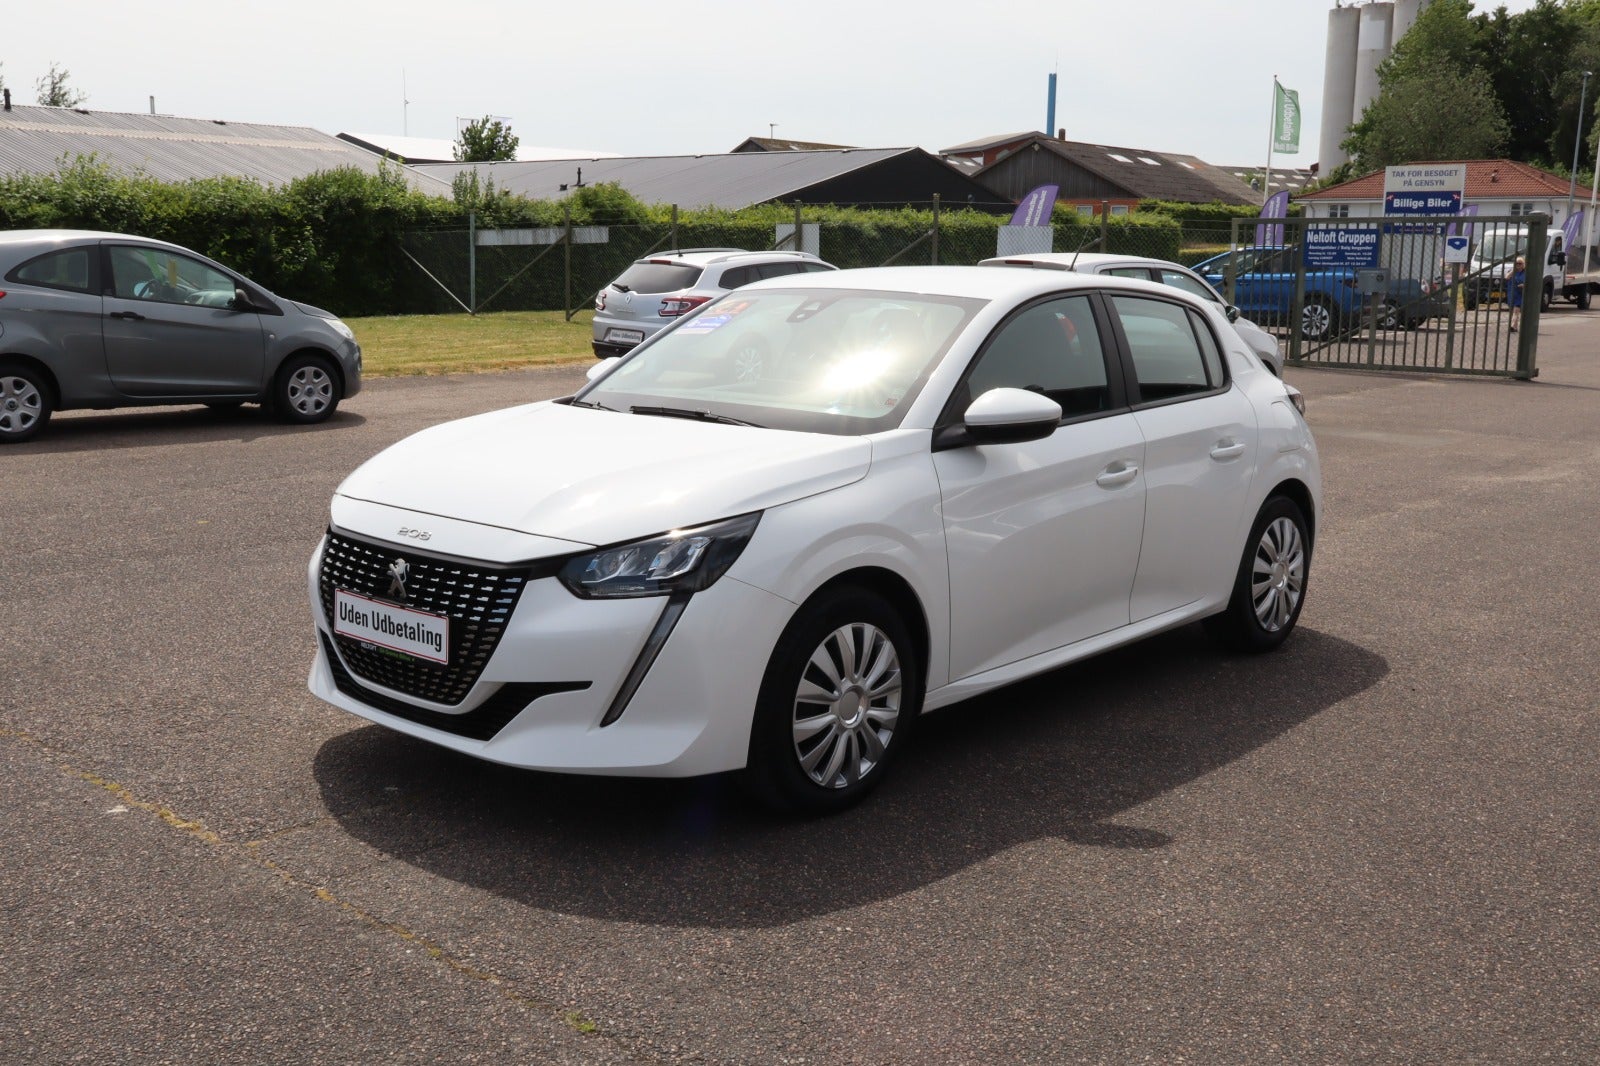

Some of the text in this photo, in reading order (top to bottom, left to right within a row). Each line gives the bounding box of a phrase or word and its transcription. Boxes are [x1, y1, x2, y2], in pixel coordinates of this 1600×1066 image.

[1392, 170, 1405, 178] TAK
[1424, 169, 1458, 177] BESØGET
[1403, 179, 1445, 187] PÅ GENSYN
[1393, 197, 1452, 209] Billige Biler
[1306, 230, 1376, 245] Neltoft Gruppen
[339, 600, 442, 652] Uden Udbetaling
